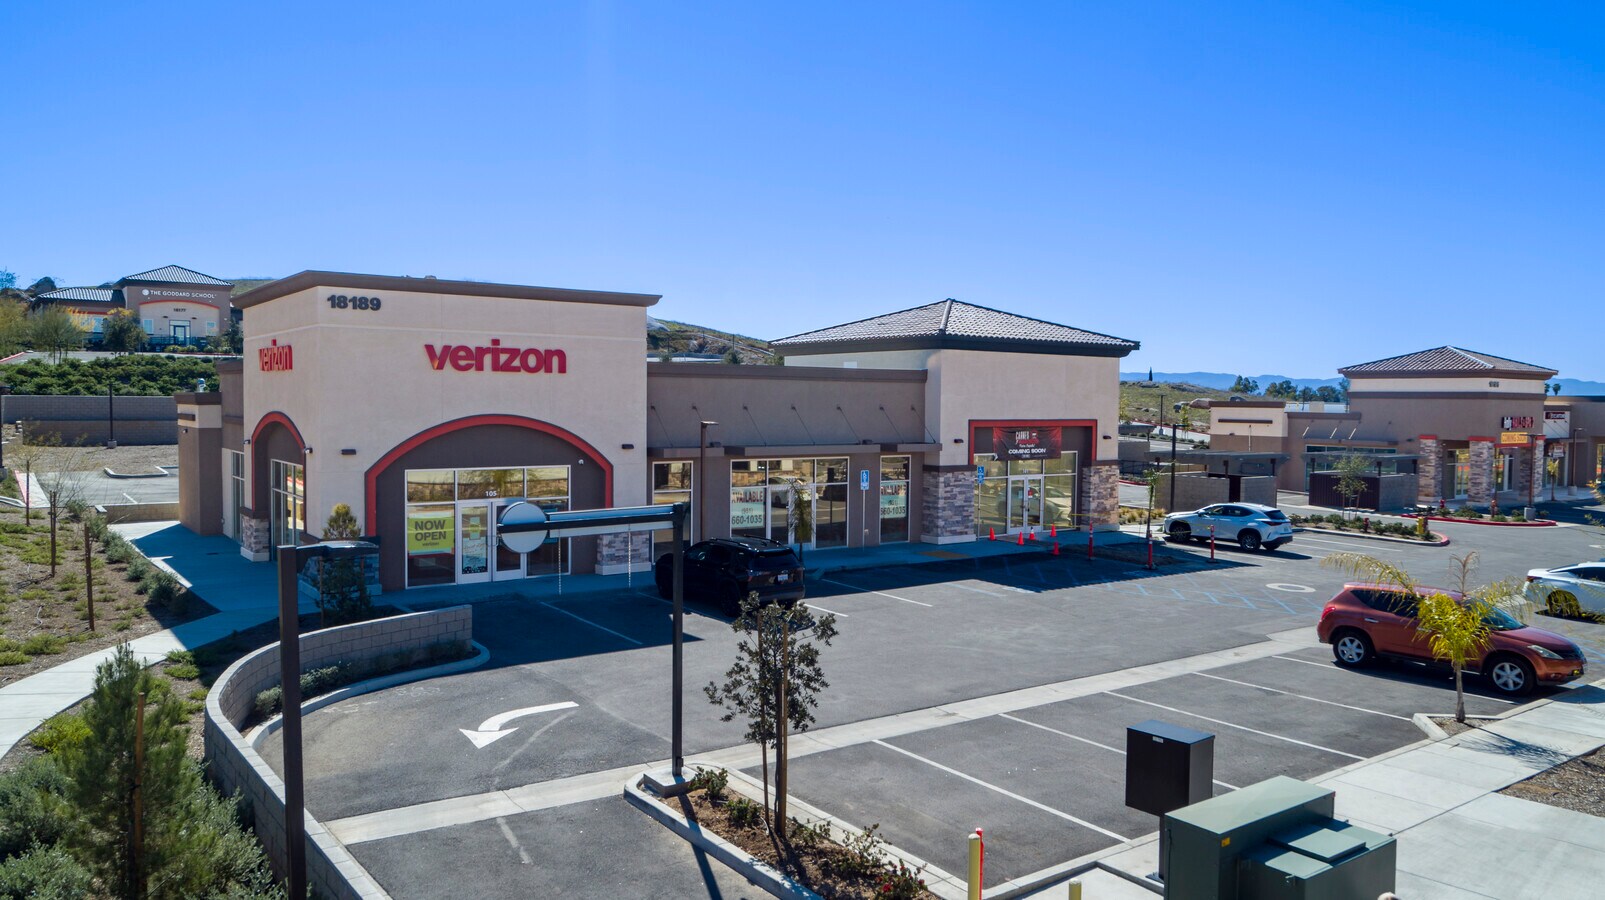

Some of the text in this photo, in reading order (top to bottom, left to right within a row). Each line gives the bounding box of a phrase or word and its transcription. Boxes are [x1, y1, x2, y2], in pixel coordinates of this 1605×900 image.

[327, 295, 381, 311] 18189
[258, 339, 293, 372] verizon
[424, 339, 567, 374] verizon
[415, 520, 446, 531] NOW
[732, 514, 763, 525] 660-1035
[415, 531, 447, 542] OPEN
